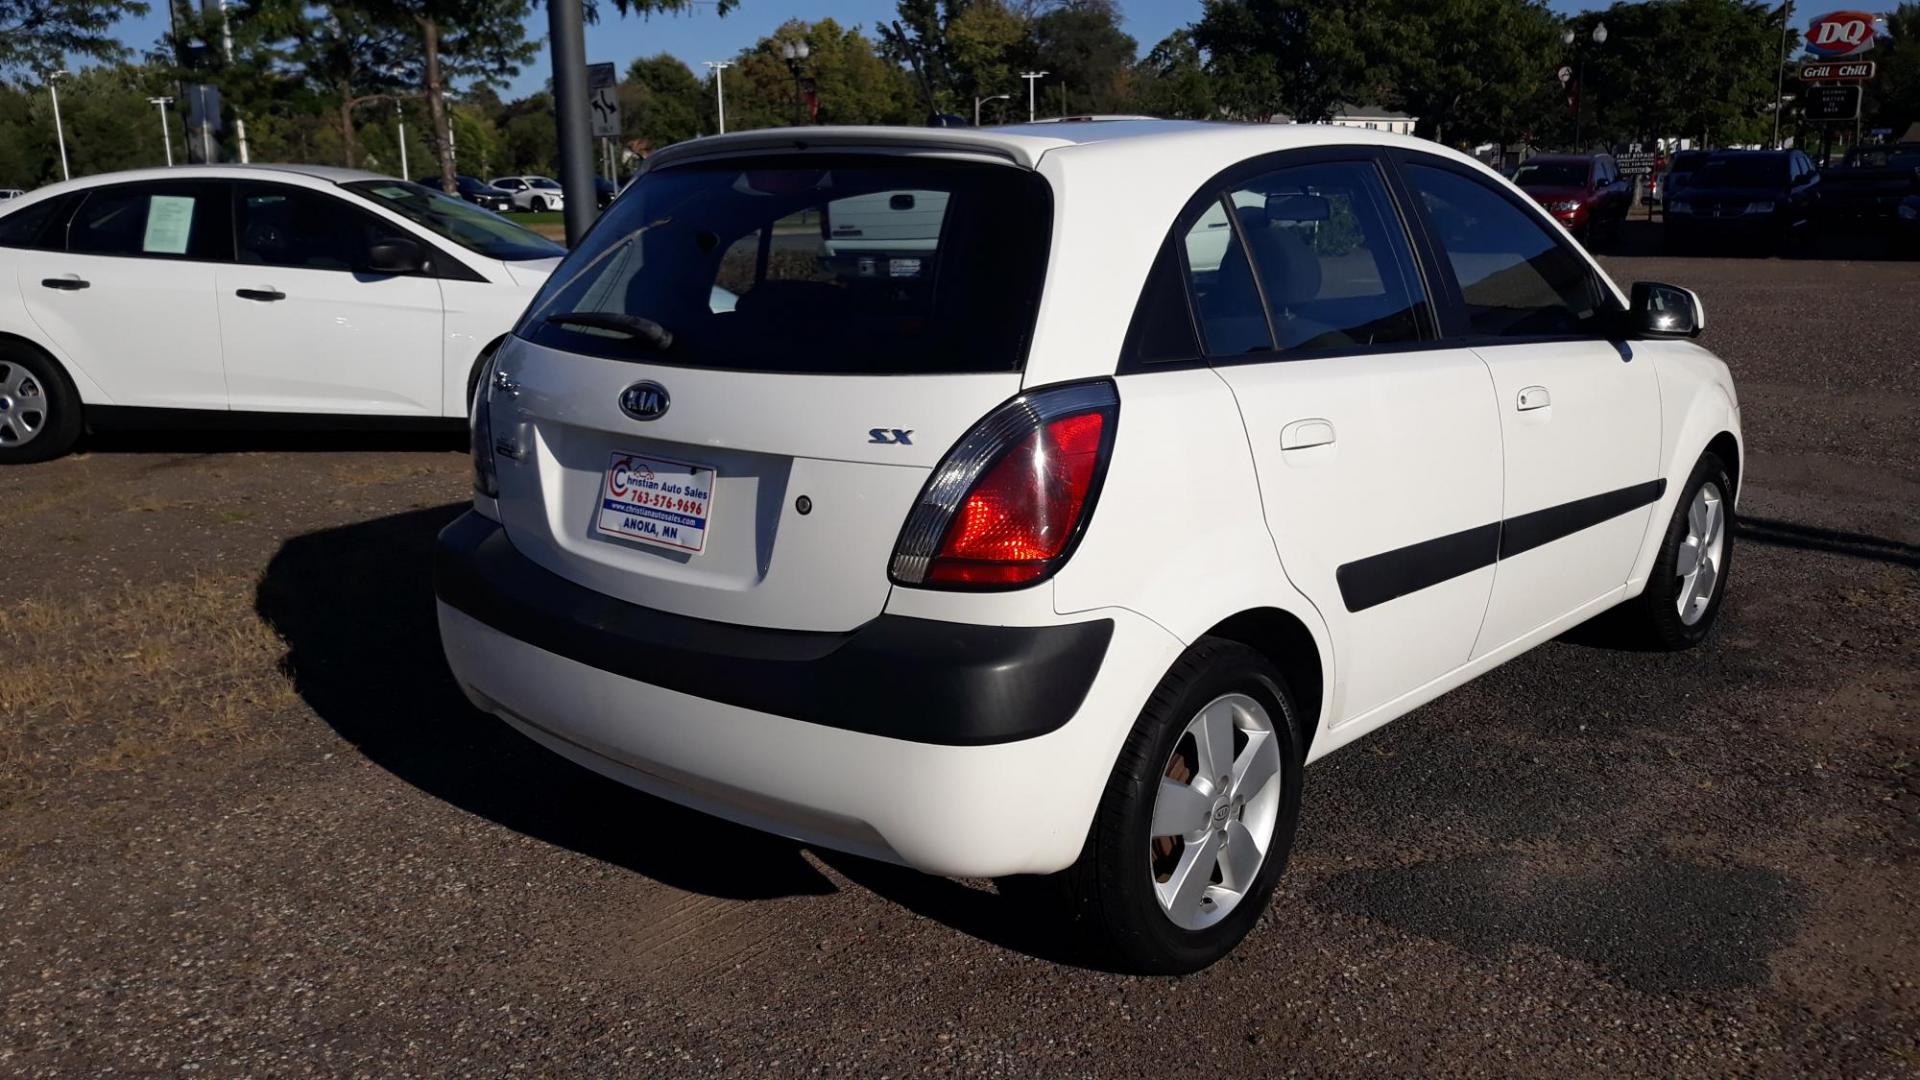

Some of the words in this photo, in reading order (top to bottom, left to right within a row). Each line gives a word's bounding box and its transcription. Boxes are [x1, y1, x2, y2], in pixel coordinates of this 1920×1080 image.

[1816, 20, 1865, 46] DQ
[1804, 66, 1831, 77] Grill
[1838, 65, 1868, 76] Chill
[627, 390, 658, 412] KIA
[868, 428, 914, 445] SX
[661, 481, 682, 495] Auto
[684, 485, 708, 500] Sales
[631, 489, 702, 516] 763-576-9696
[611, 502, 696, 526] www.christianautosales.com
[623, 517, 659, 538] ANOKA,
[662, 525, 678, 539] MN
